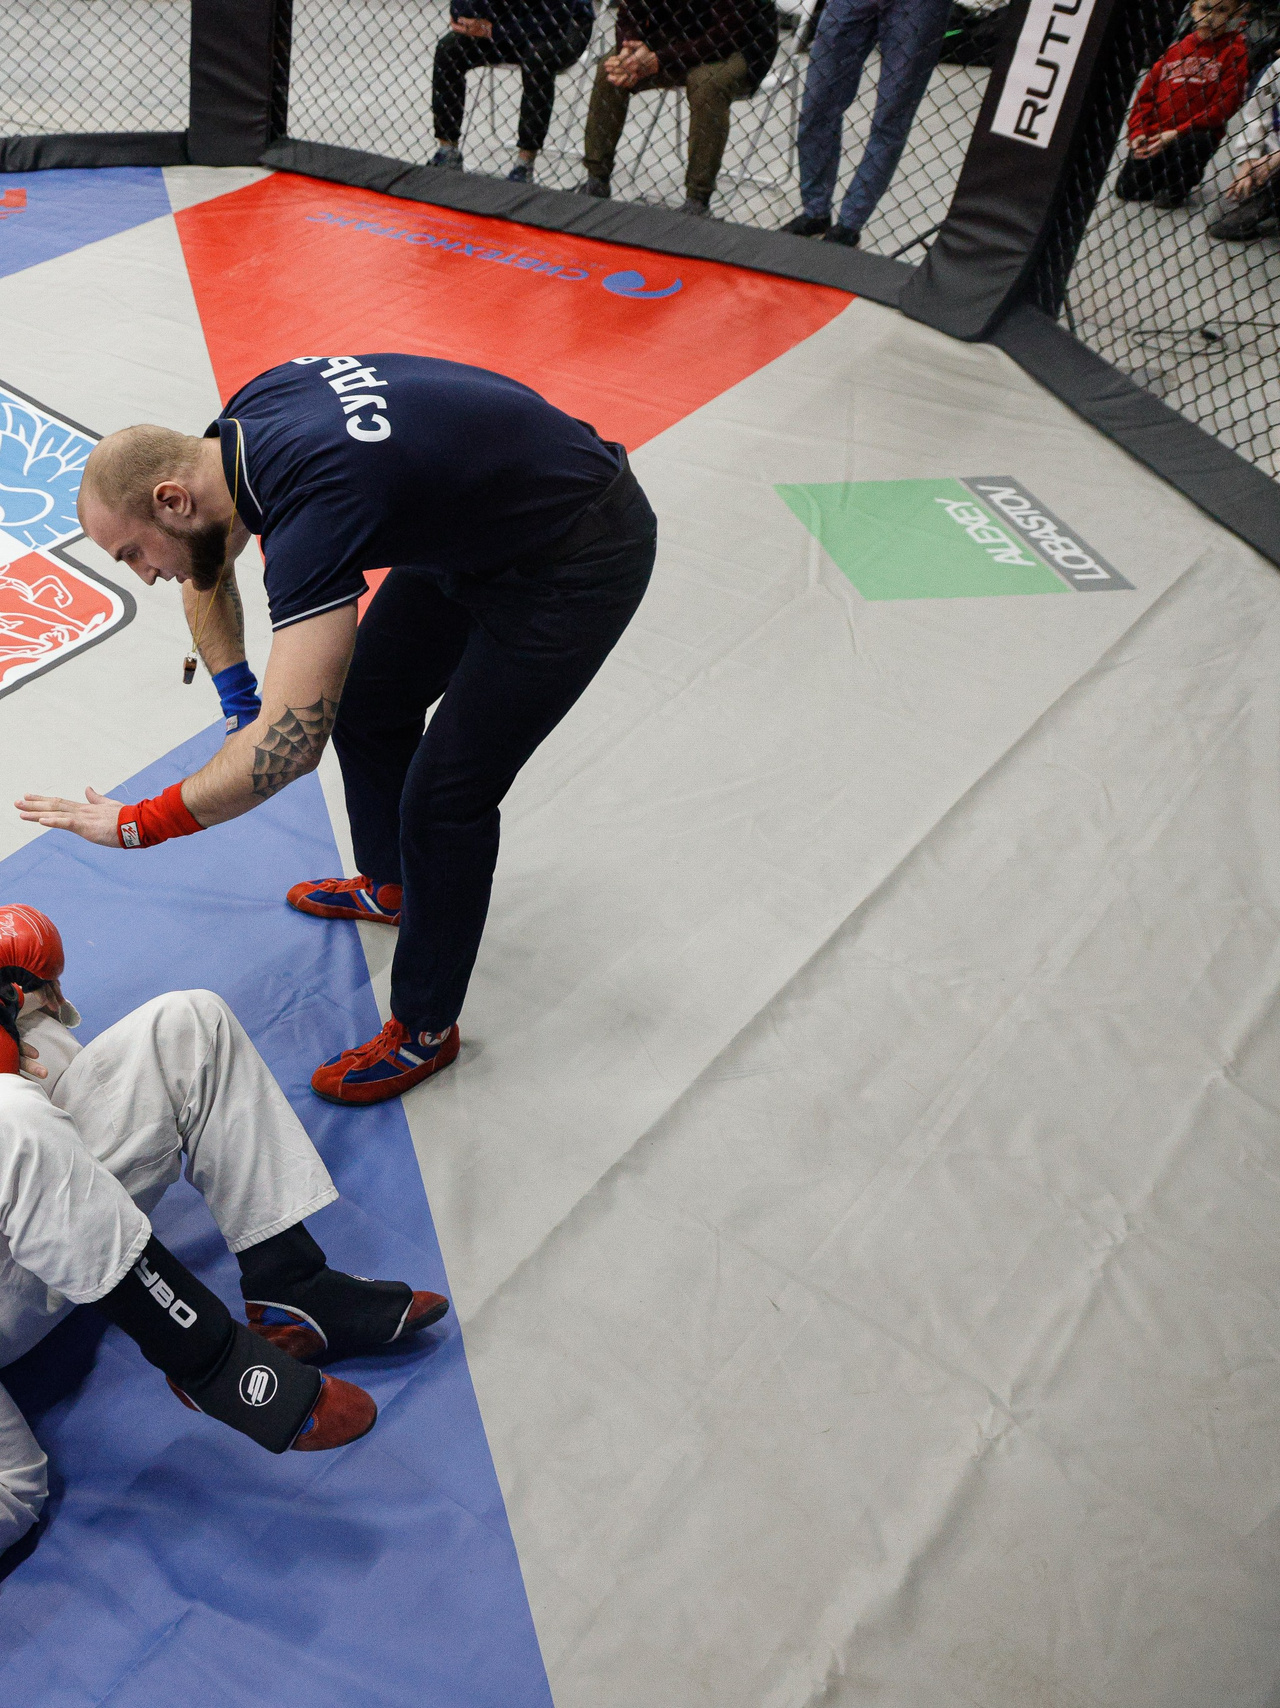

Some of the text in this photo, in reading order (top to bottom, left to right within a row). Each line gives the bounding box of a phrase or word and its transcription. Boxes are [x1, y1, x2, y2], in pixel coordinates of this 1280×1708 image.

[934, 497, 1037, 567] ALEXEY
[976, 484, 1111, 580] LOBASTOV
[132, 1254, 198, 1329] YBO
